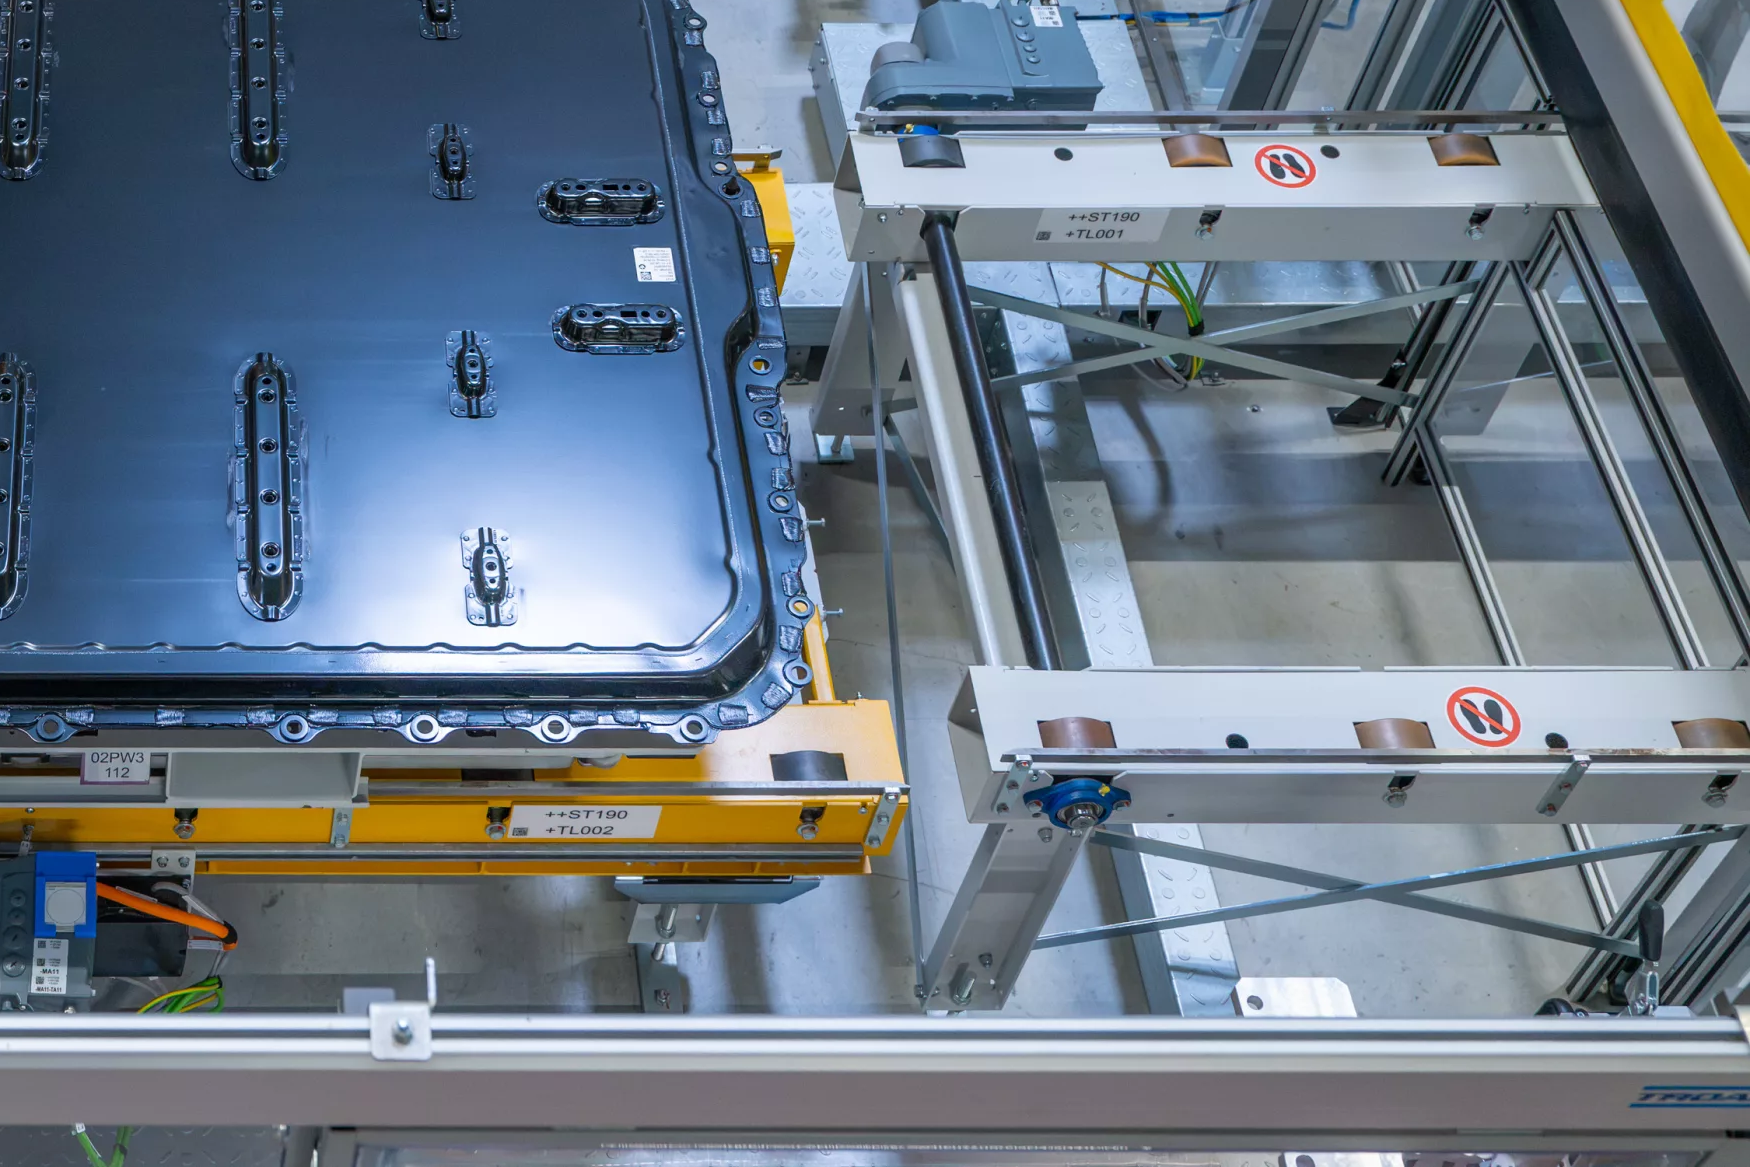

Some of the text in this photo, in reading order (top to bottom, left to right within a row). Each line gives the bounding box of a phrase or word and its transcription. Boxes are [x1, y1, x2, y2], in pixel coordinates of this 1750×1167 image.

[1068, 212, 1141, 223] ++ST190
[1065, 229, 1125, 239] +TL001
[90, 751, 145, 764] 02PW3
[105, 766, 130, 779] 112
[545, 809, 629, 820] ++ST190
[545, 825, 615, 836] +TL002
